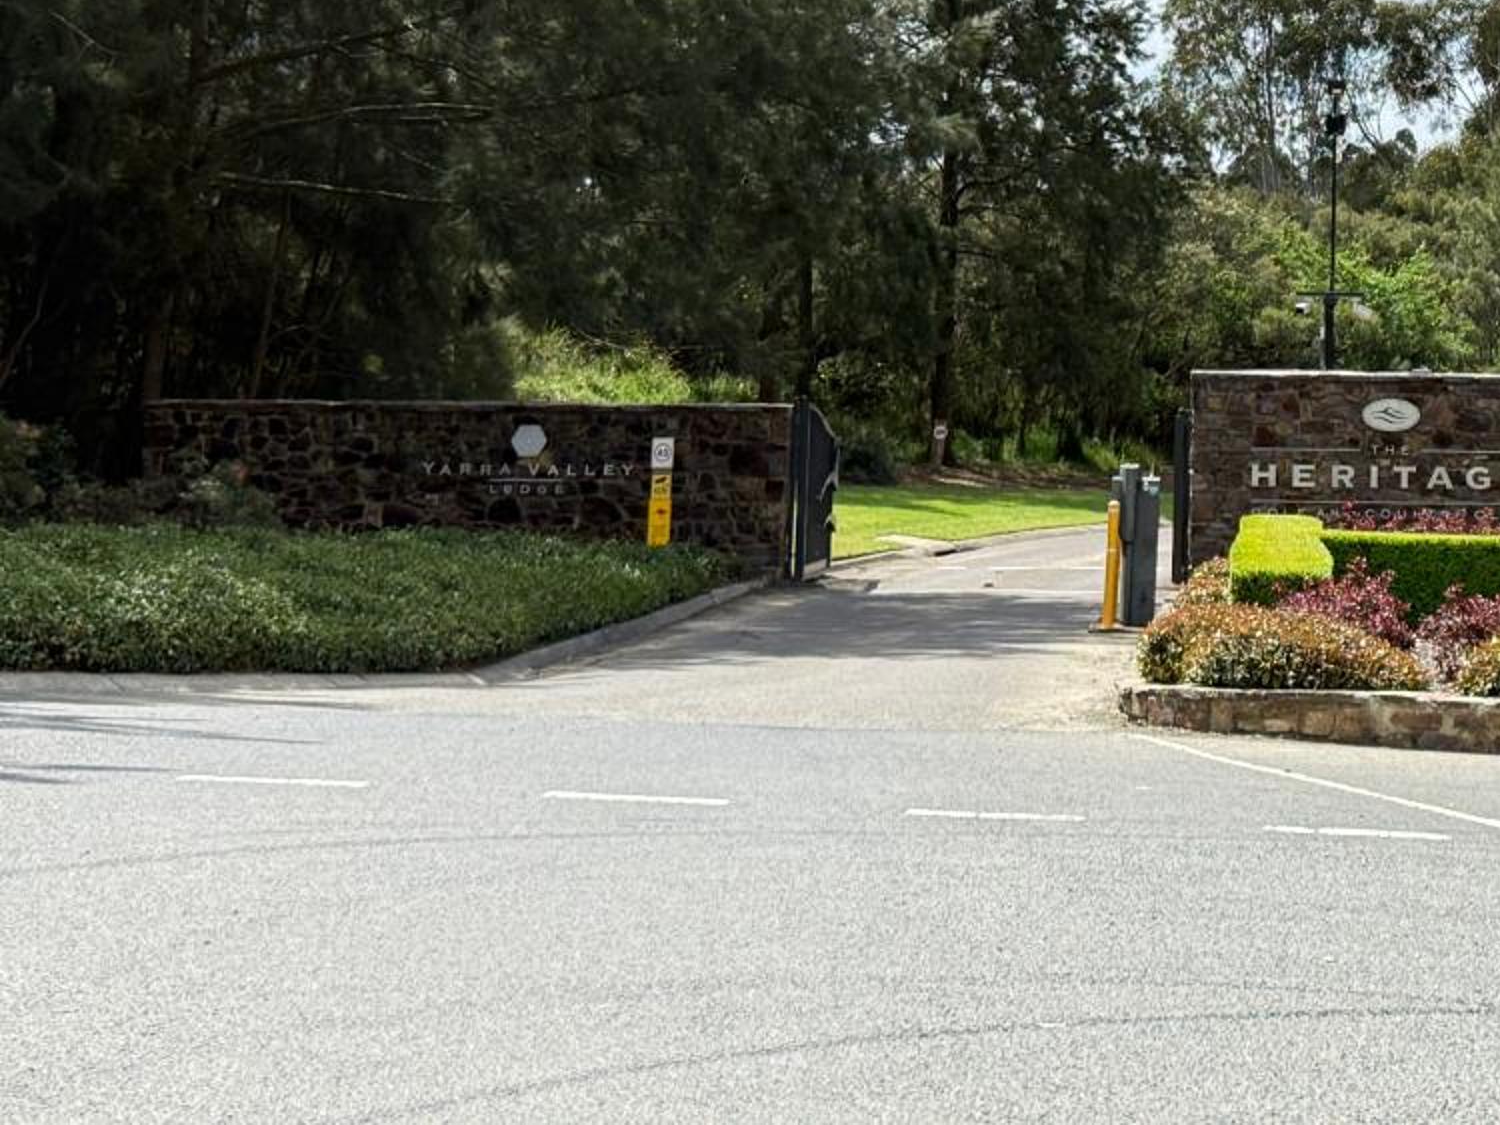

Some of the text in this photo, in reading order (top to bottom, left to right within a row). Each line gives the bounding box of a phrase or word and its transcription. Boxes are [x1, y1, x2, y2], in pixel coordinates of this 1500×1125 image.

[1372, 445, 1409, 455] THE
[422, 461, 634, 476] YARRA VALLEY
